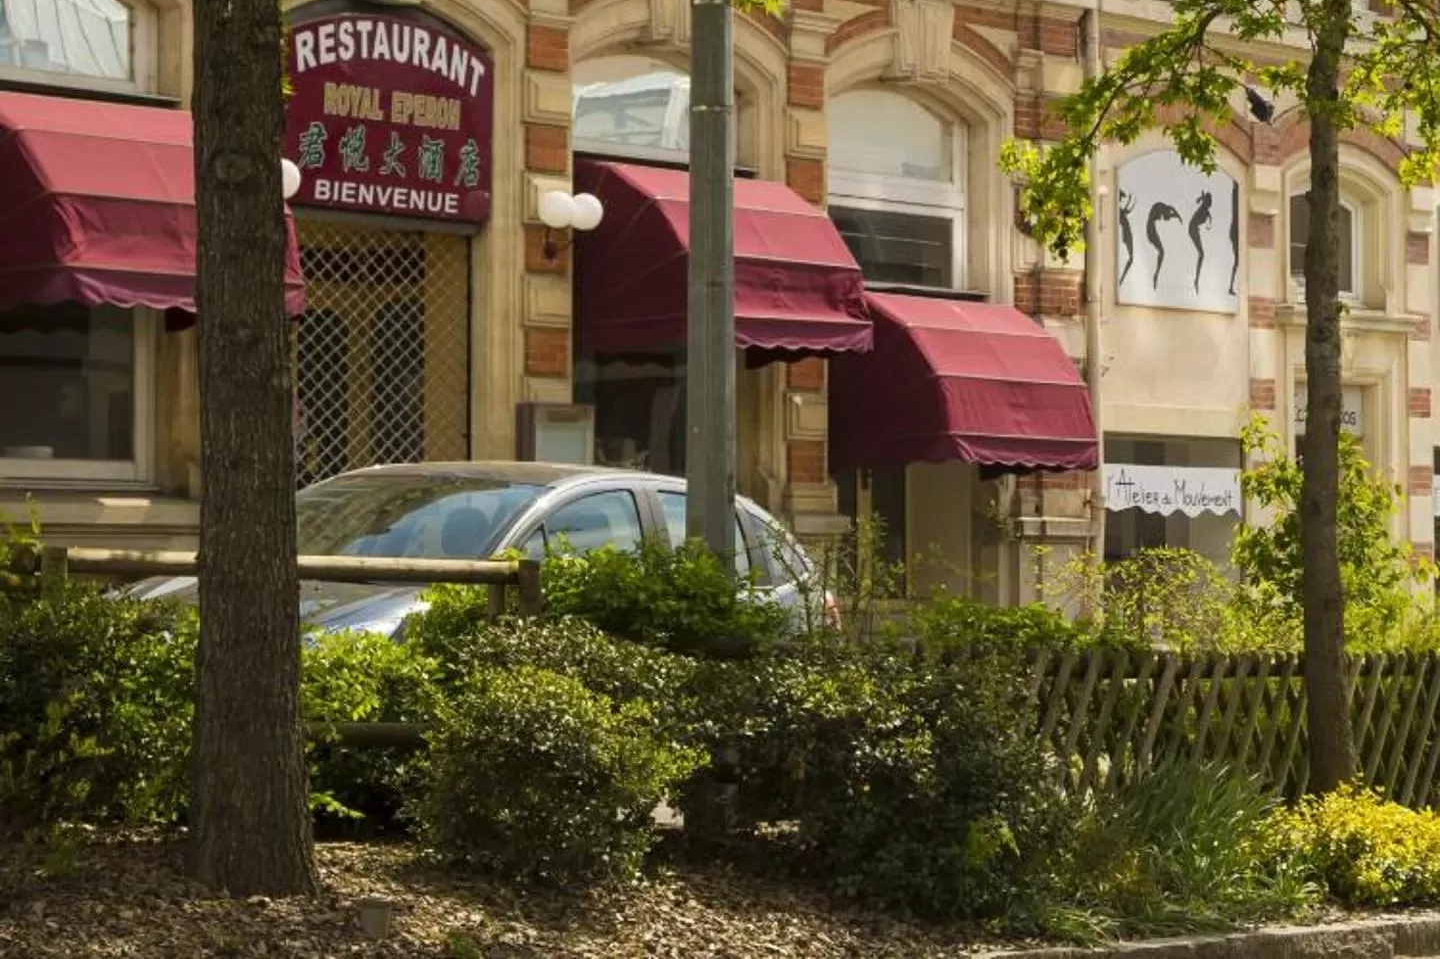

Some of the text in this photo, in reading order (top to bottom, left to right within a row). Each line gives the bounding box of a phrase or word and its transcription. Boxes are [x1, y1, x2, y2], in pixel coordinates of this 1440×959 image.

[294, 20, 485, 98] RESTAURANT
[323, 82, 462, 131] ROYAL EPERON
[314, 179, 460, 214] BIENVENUE
